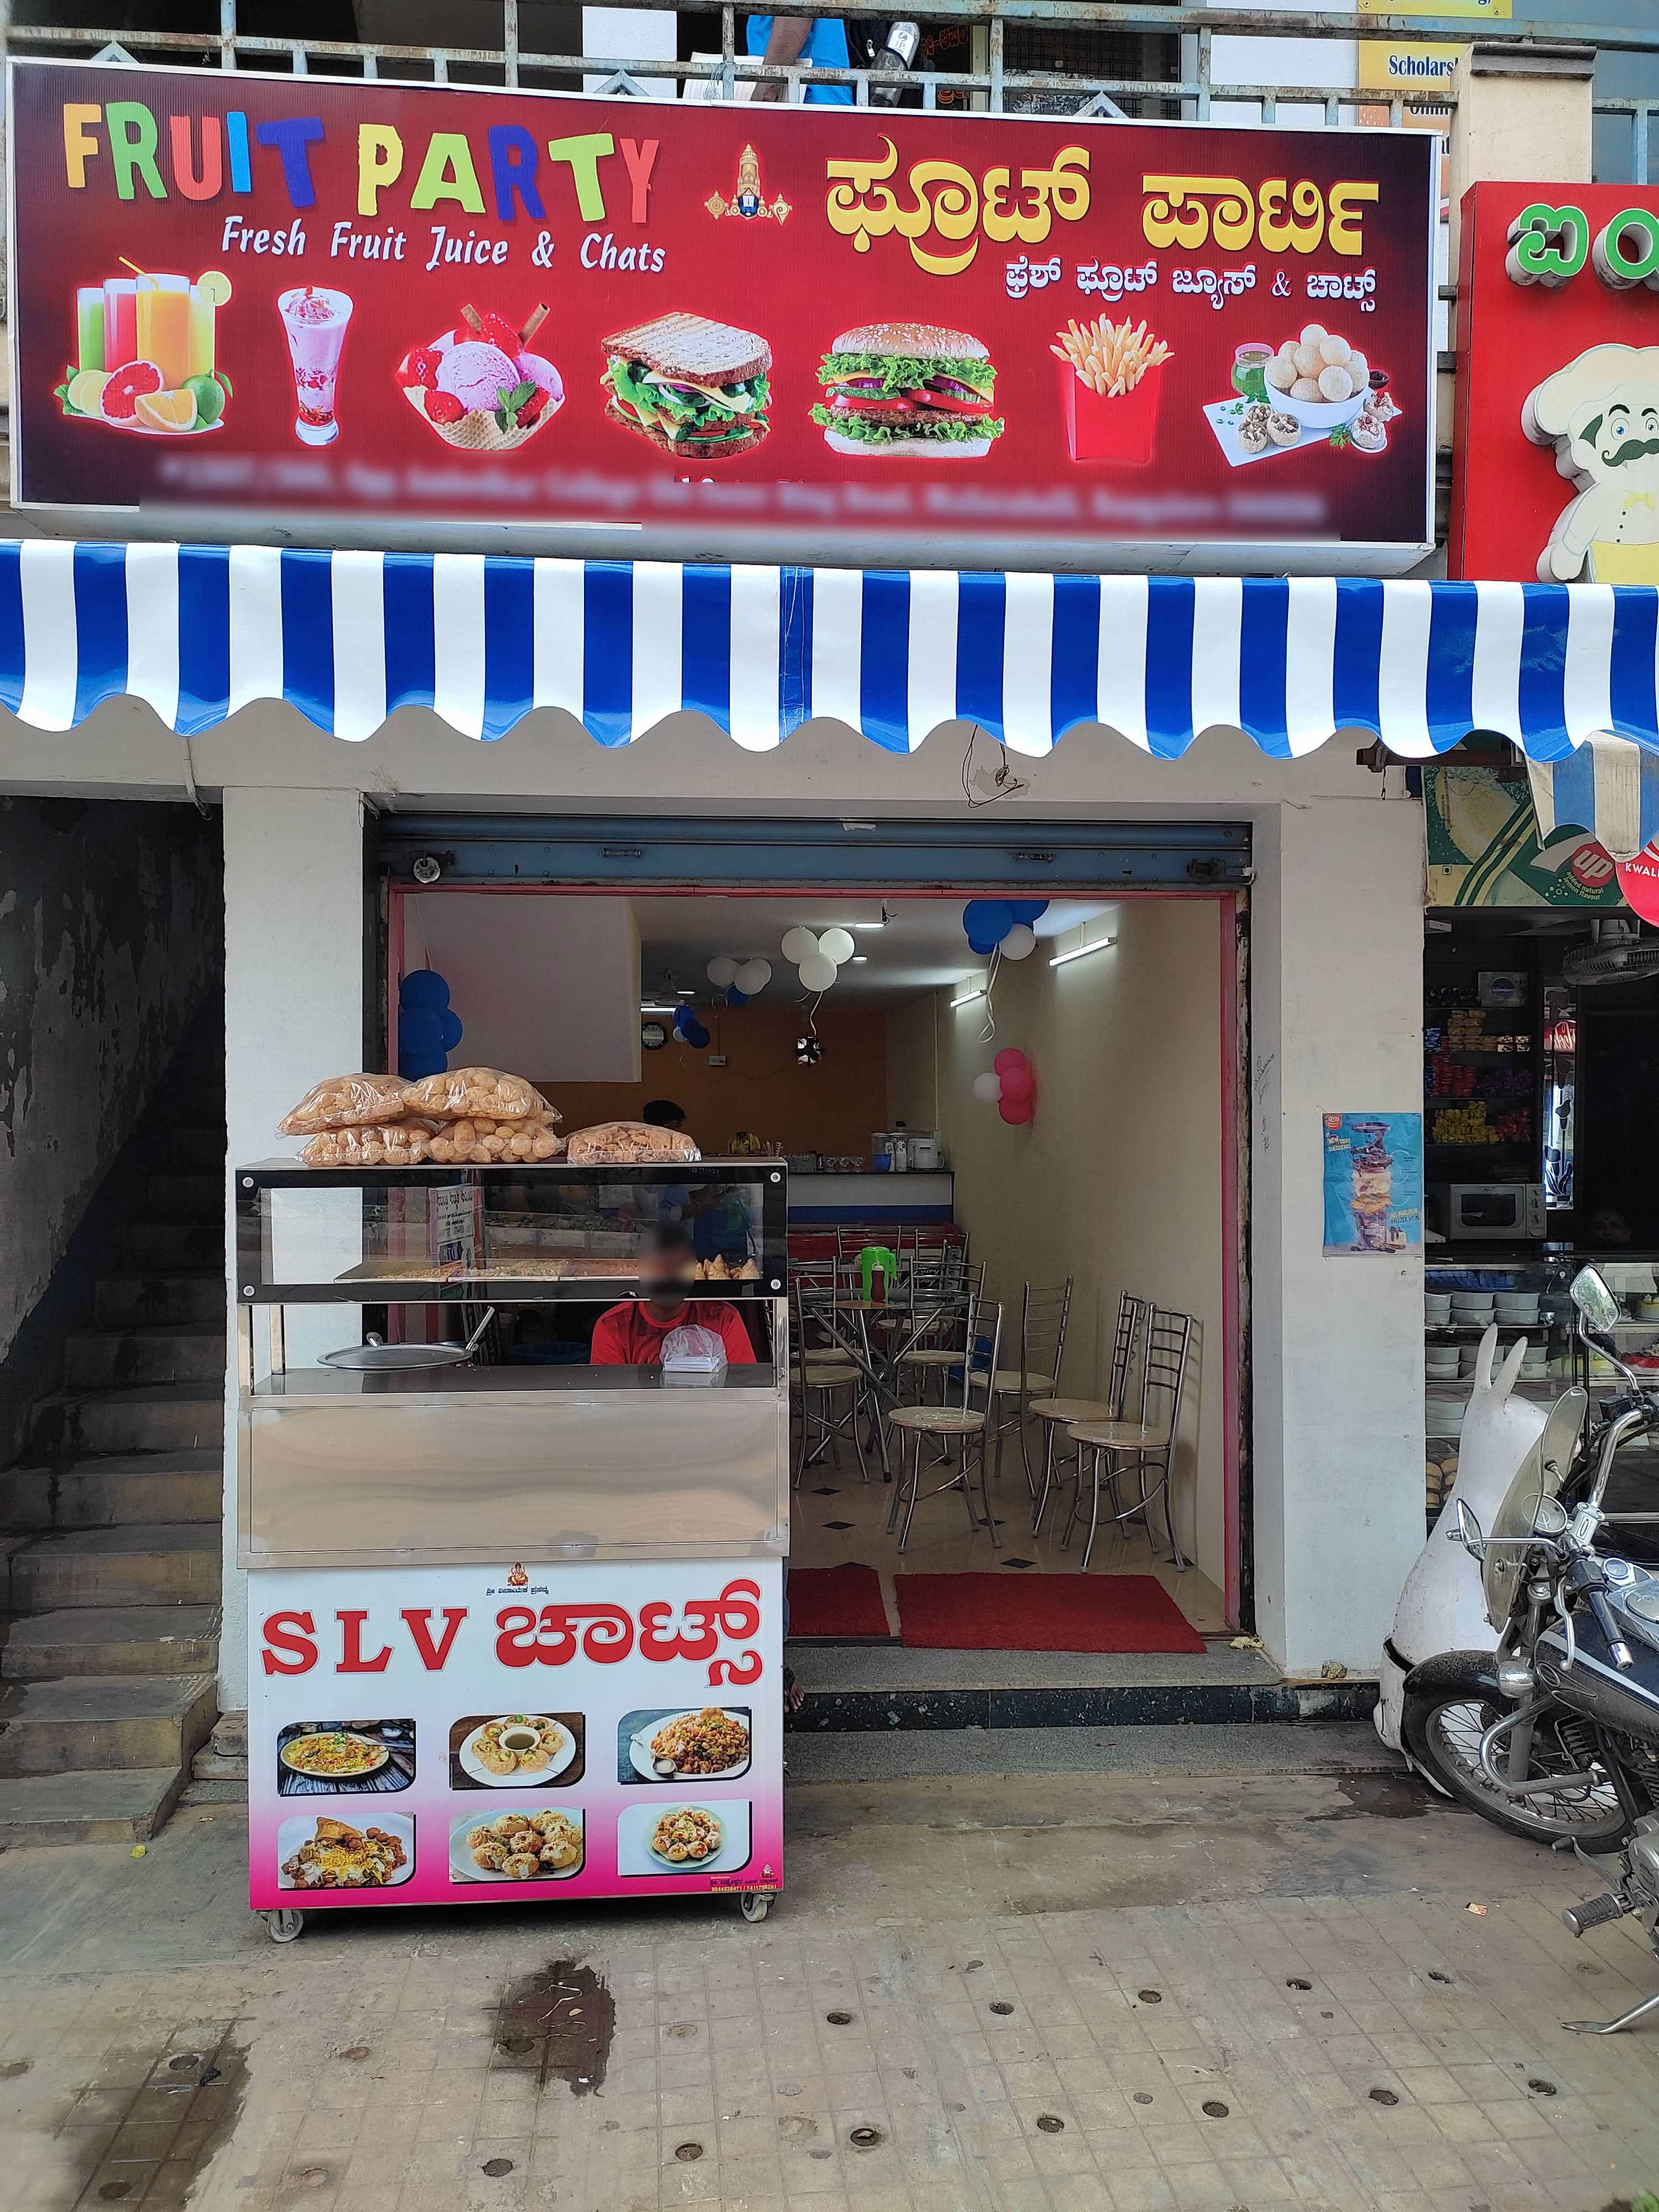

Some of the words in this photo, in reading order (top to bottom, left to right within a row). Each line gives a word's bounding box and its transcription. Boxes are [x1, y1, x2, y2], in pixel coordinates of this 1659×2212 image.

[1389, 54, 1457, 76] Scholars
[62, 101, 325, 209] FRUIT
[357, 123, 660, 224] PARTY
[826, 133, 1091, 275] ಫ್ರೂಟ್
[1142, 173, 1379, 256] ಪಾರ್ಟಿ
[222, 216, 306, 257] Fresh
[330, 221, 406, 261] Fruit
[426, 226, 508, 272] Juice
[531, 231, 555, 269] &
[580, 233, 666, 273] Chats
[1005, 255, 1062, 299] ಫ್ರೆಶ್
[1172, 265, 1256, 310] ಜ್ಯೂಸ್
[1272, 271, 1291, 297] &
[1307, 269, 1376, 312] ಚಾಟ್ಸ್
[1563, 876, 1579, 894] lemon
[1579, 891, 1600, 900] flavour
[1566, 872, 1582, 889] added
[260, 1606, 469, 1677] SLV
[495, 1578, 765, 1688] ಚಾಟ್ಸ್
